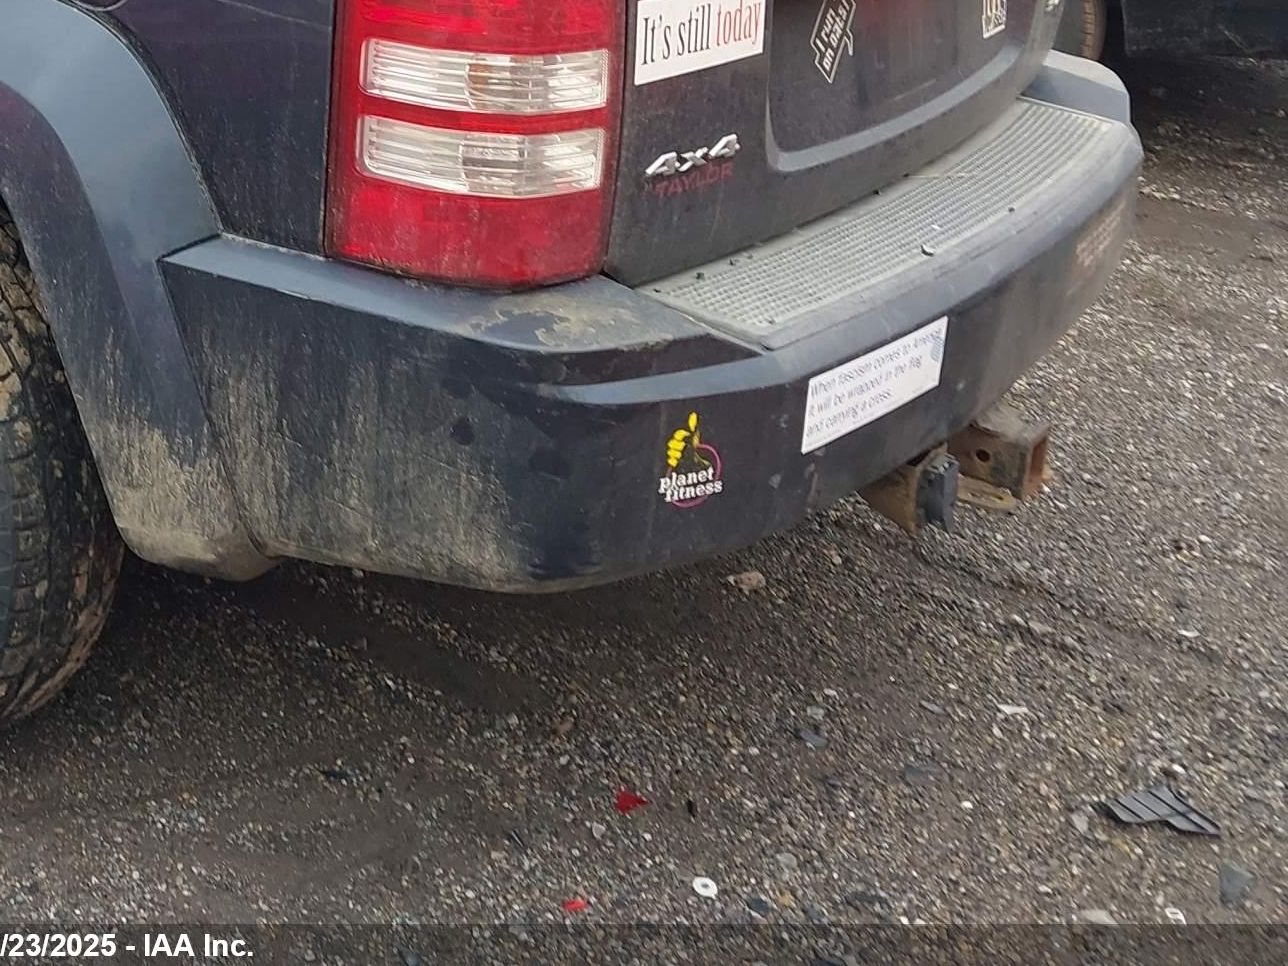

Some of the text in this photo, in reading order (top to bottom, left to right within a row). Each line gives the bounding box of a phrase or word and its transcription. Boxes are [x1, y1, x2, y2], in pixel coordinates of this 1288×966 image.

[641, 13, 672, 66] It's
[677, 2, 712, 56] still
[821, 7, 837, 43] run
[822, 46, 835, 72] on
[644, 133, 741, 177] 4x4
[658, 466, 714, 494] planet
[664, 480, 723, 502] fitness
